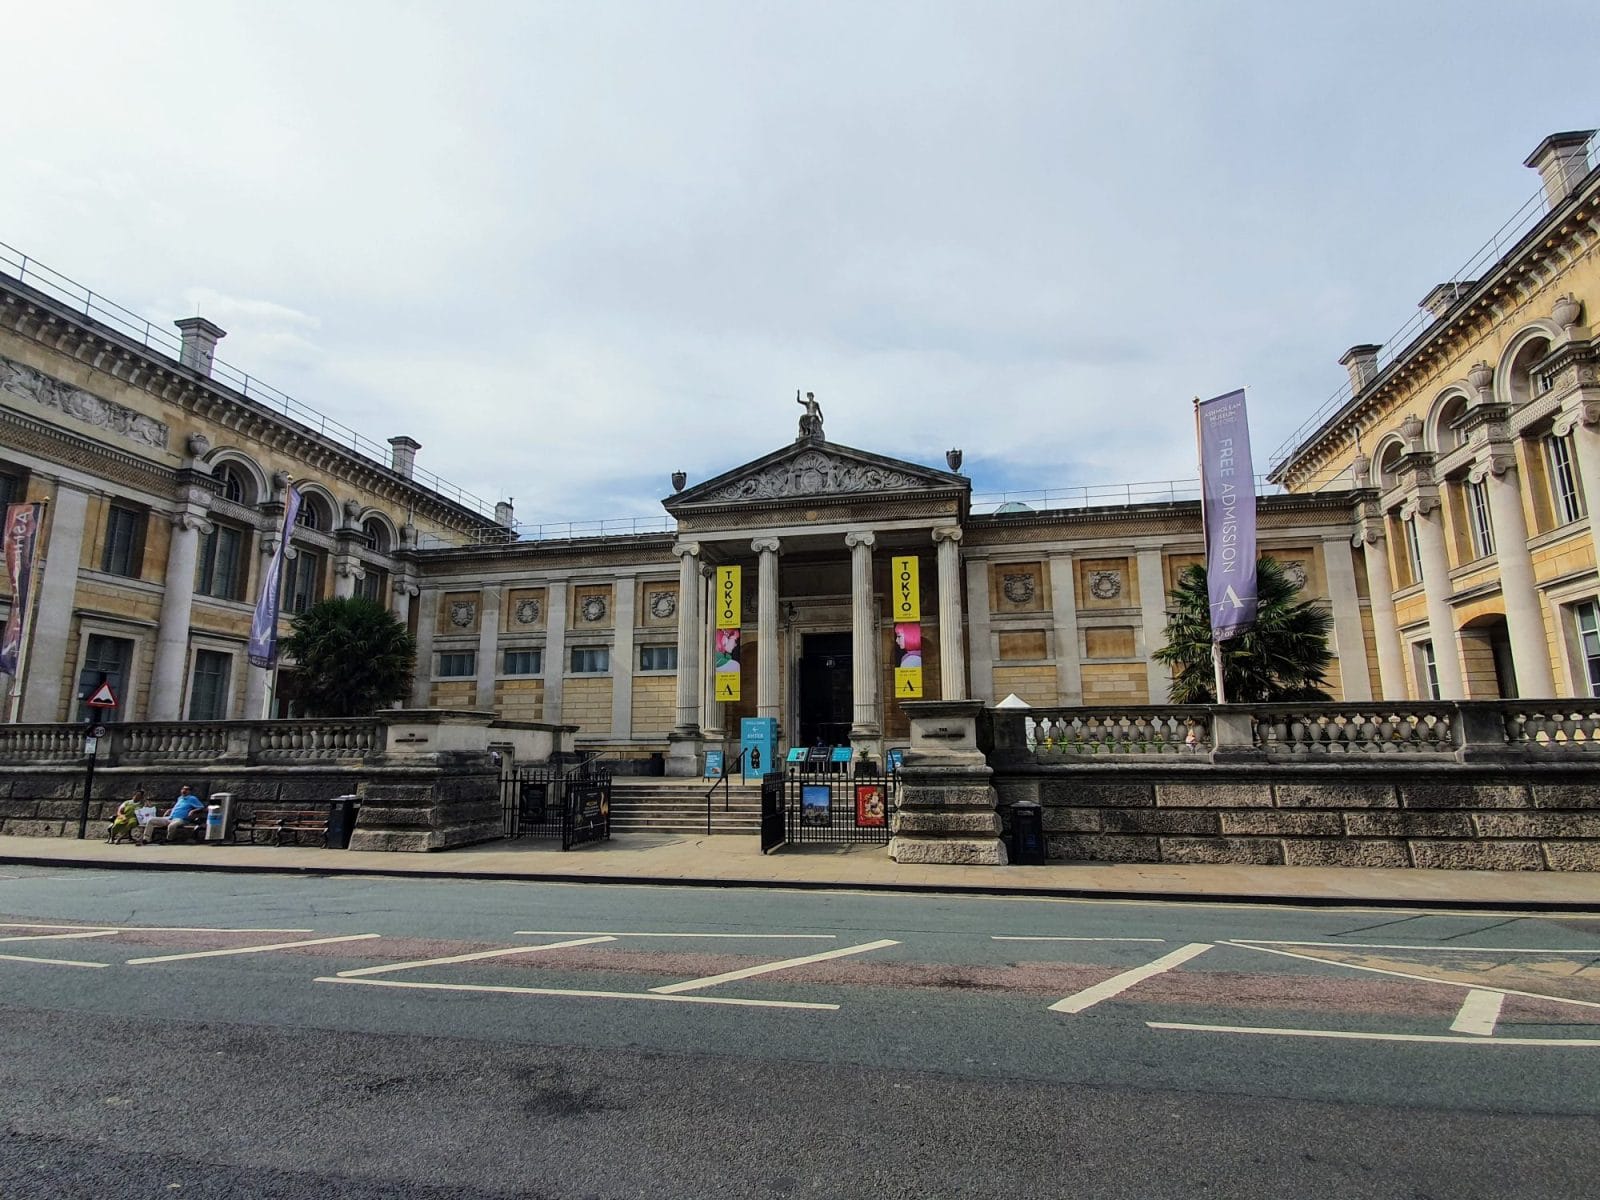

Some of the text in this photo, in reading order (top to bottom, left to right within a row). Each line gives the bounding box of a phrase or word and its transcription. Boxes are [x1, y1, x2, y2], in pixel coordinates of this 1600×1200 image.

[1204, 401, 1243, 418] ASHMOLEAN
[1209, 411, 1237, 421] MUSEUM
[1218, 438, 1237, 573] FREE ADMISSION
[723, 570, 734, 619] TOKYO
[900, 561, 912, 612] TOKYO
[1219, 584, 1245, 612] A
